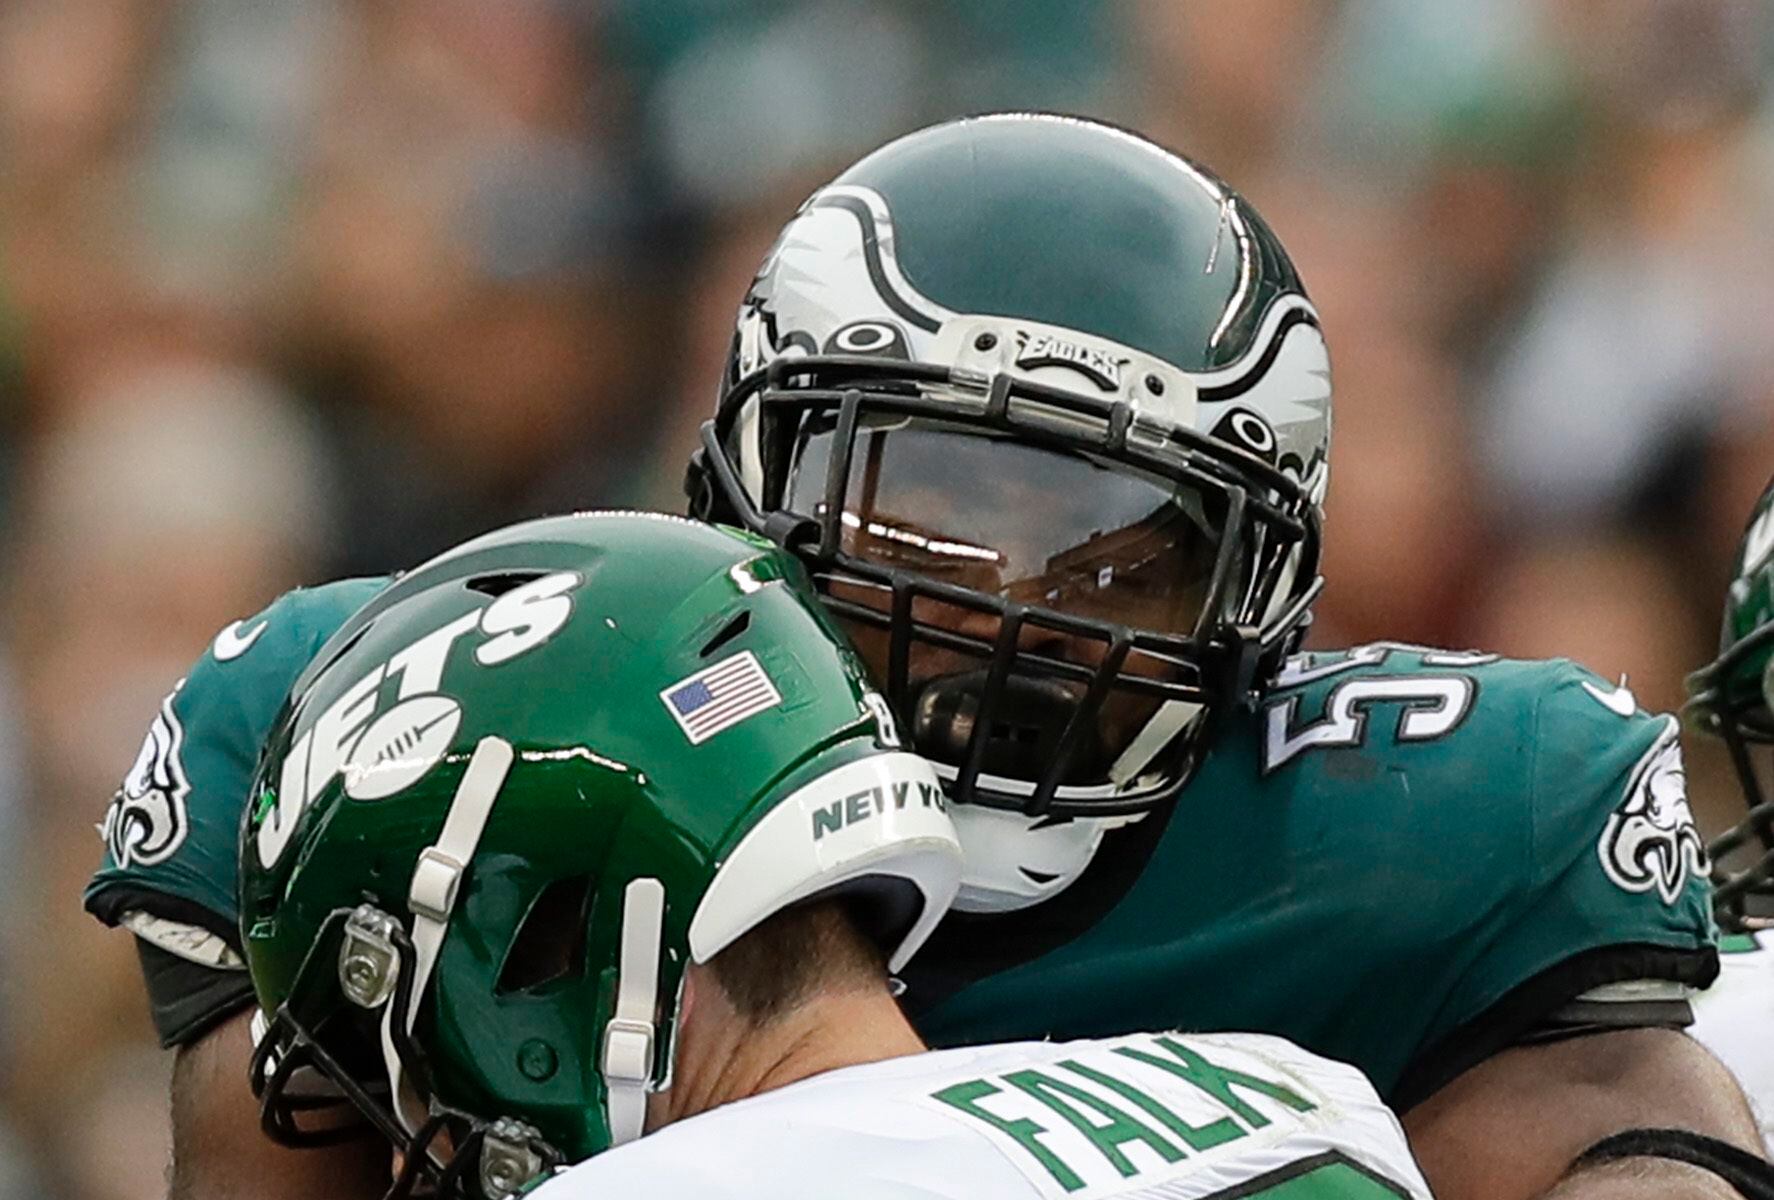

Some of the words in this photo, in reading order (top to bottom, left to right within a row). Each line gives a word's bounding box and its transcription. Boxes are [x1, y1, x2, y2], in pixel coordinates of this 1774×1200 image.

[258, 573, 582, 870] JETS
[812, 781, 909, 841] NEW
[930, 1036, 1318, 1193] FALK
